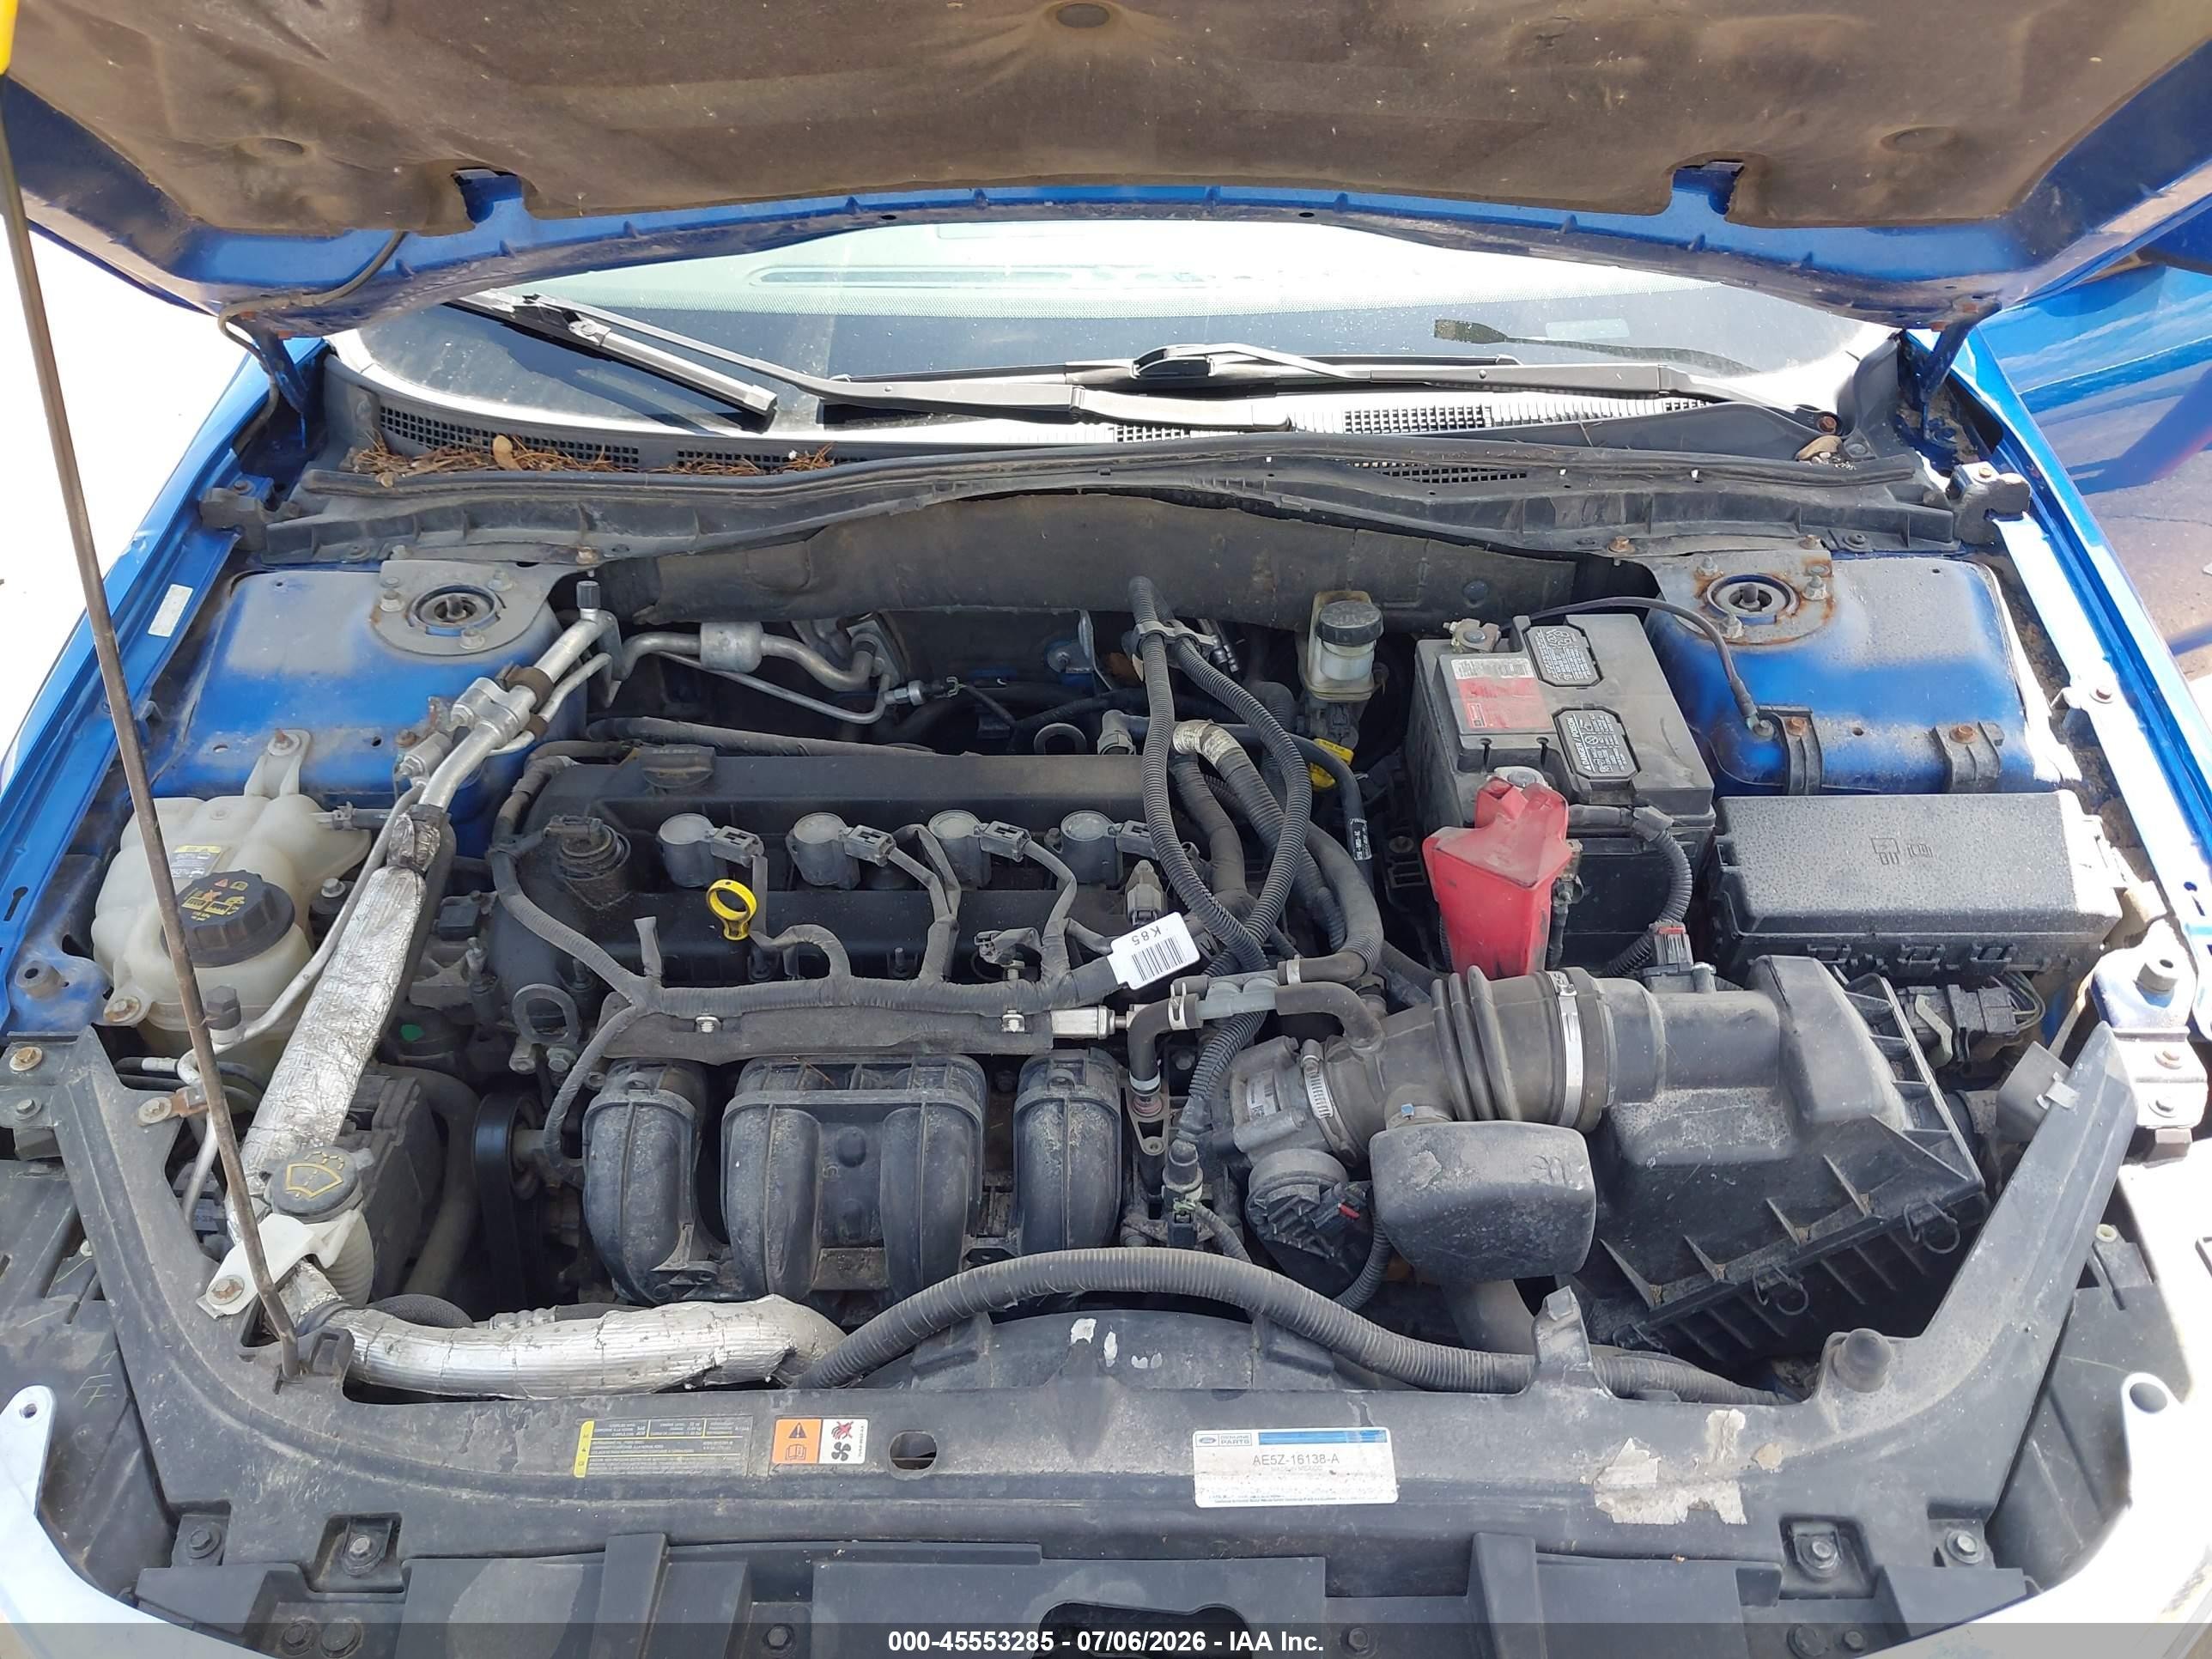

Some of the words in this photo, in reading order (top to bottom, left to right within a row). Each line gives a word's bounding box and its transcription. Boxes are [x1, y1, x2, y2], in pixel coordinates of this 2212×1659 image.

[1565, 717, 1579, 737] POISON
[1575, 742, 1590, 765] DANGER
[1132, 926, 1161, 945] K85
[1252, 1453, 1340, 1466] AE5Z-16138-A
